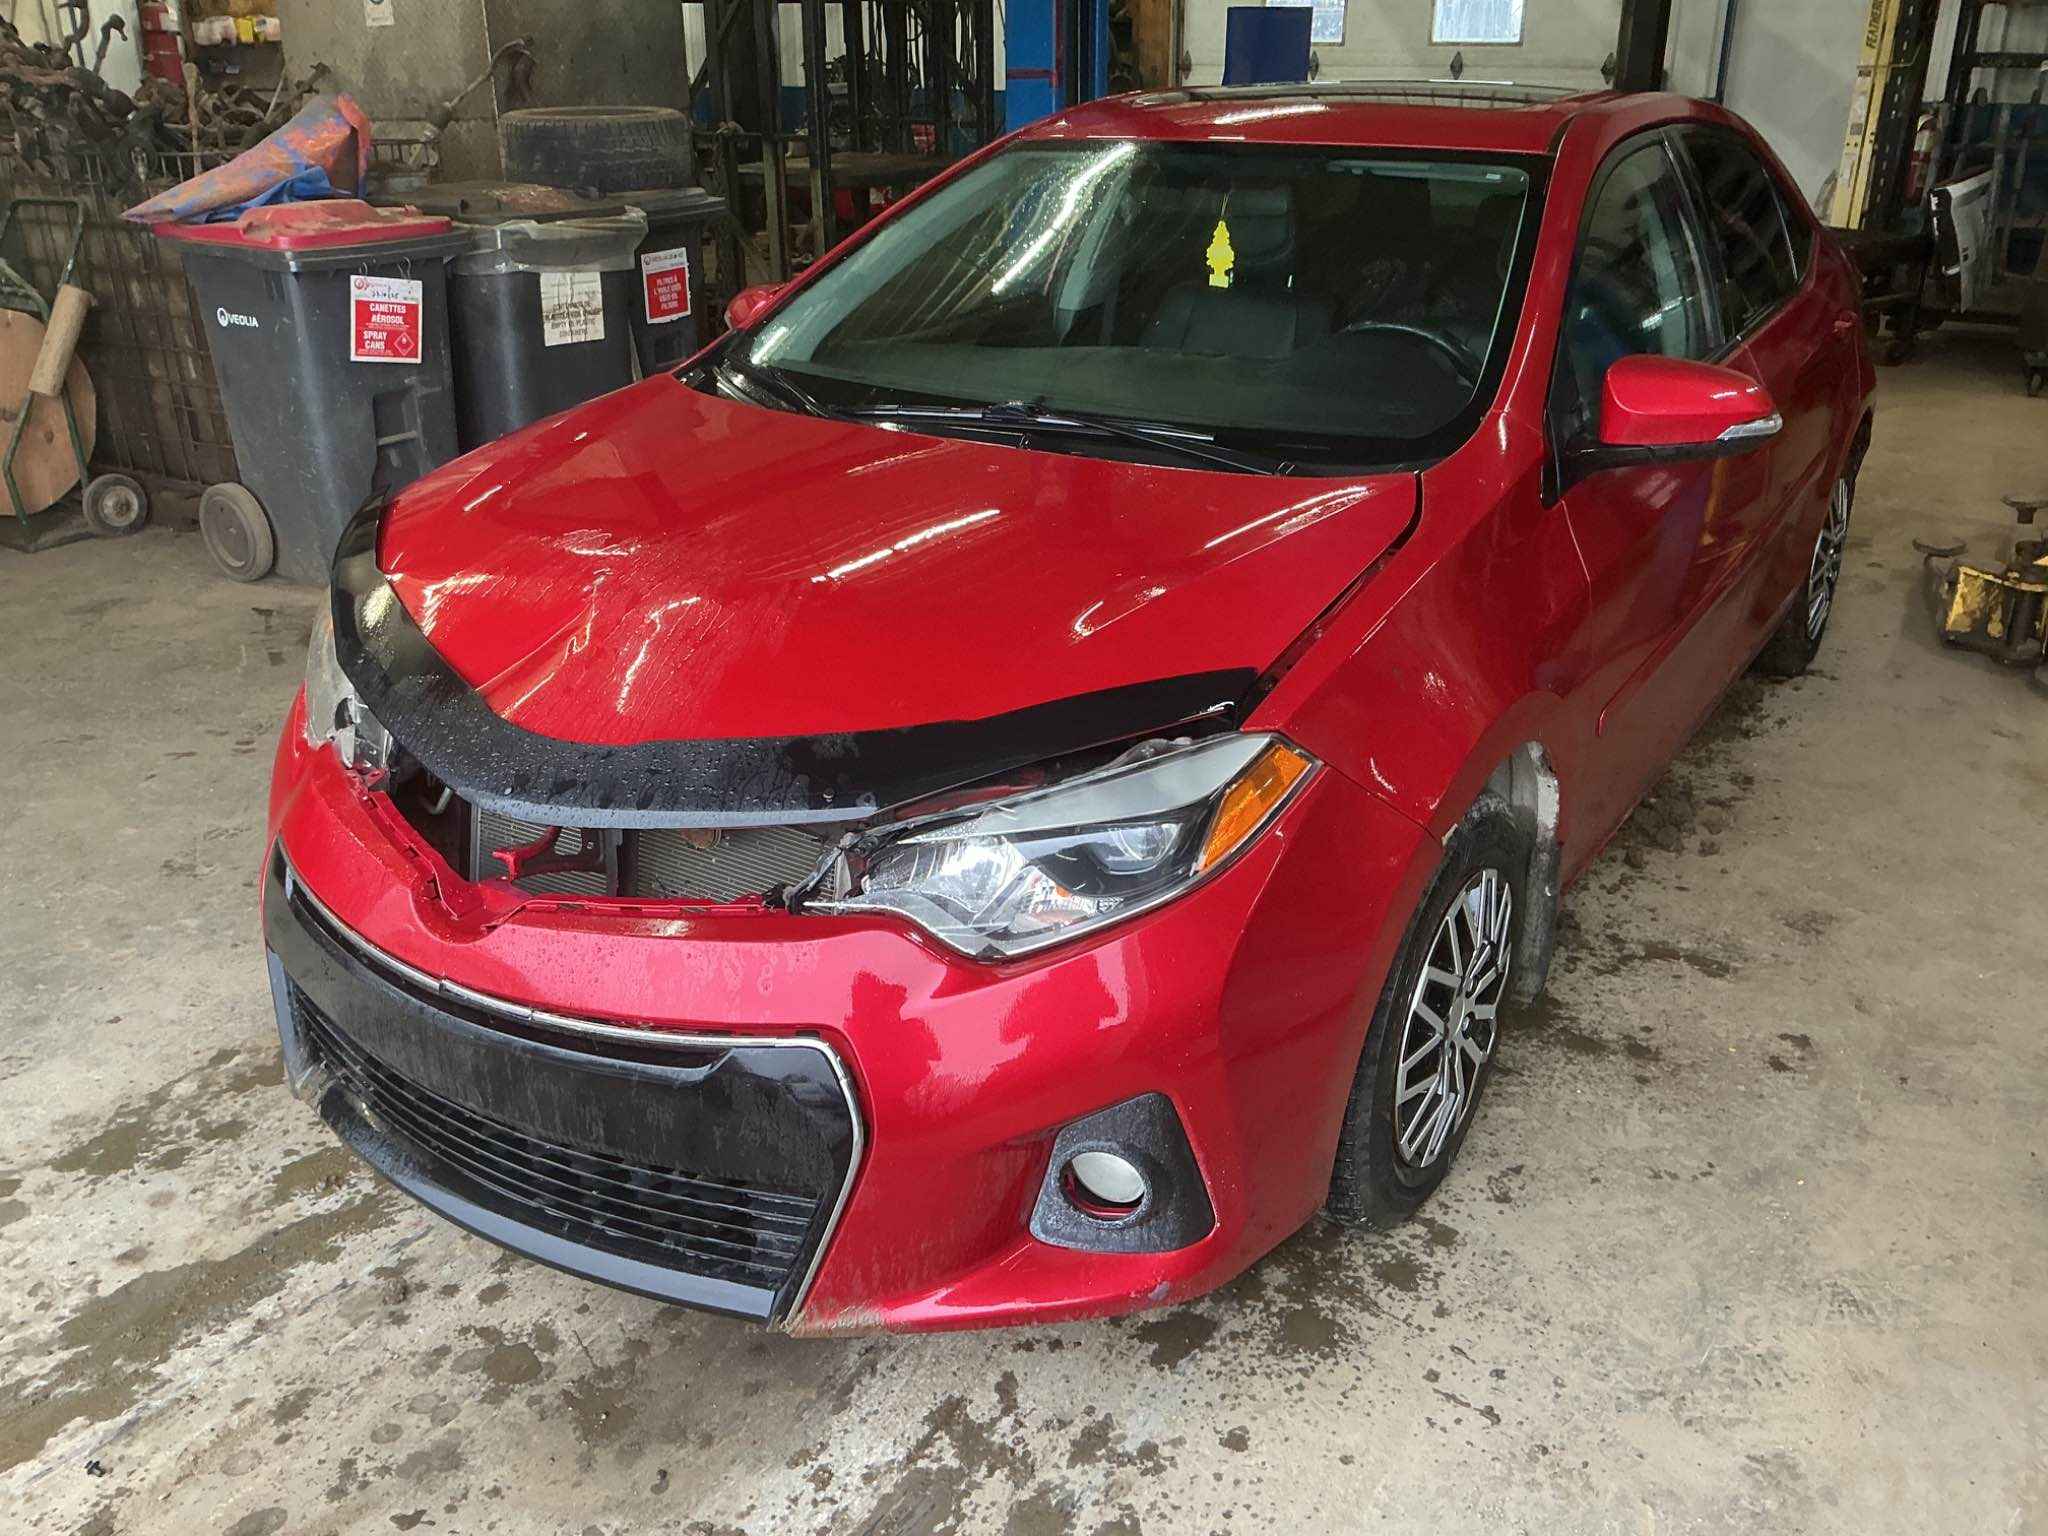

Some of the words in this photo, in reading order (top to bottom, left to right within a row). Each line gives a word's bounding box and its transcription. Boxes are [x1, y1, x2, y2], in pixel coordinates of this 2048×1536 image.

[369, 303, 406, 313] CANETTES
[226, 313, 259, 328] VEOLIA
[371, 313, 404, 324] AÉROSOL
[363, 330, 387, 340] SPRAY
[364, 340, 385, 350] CANS
